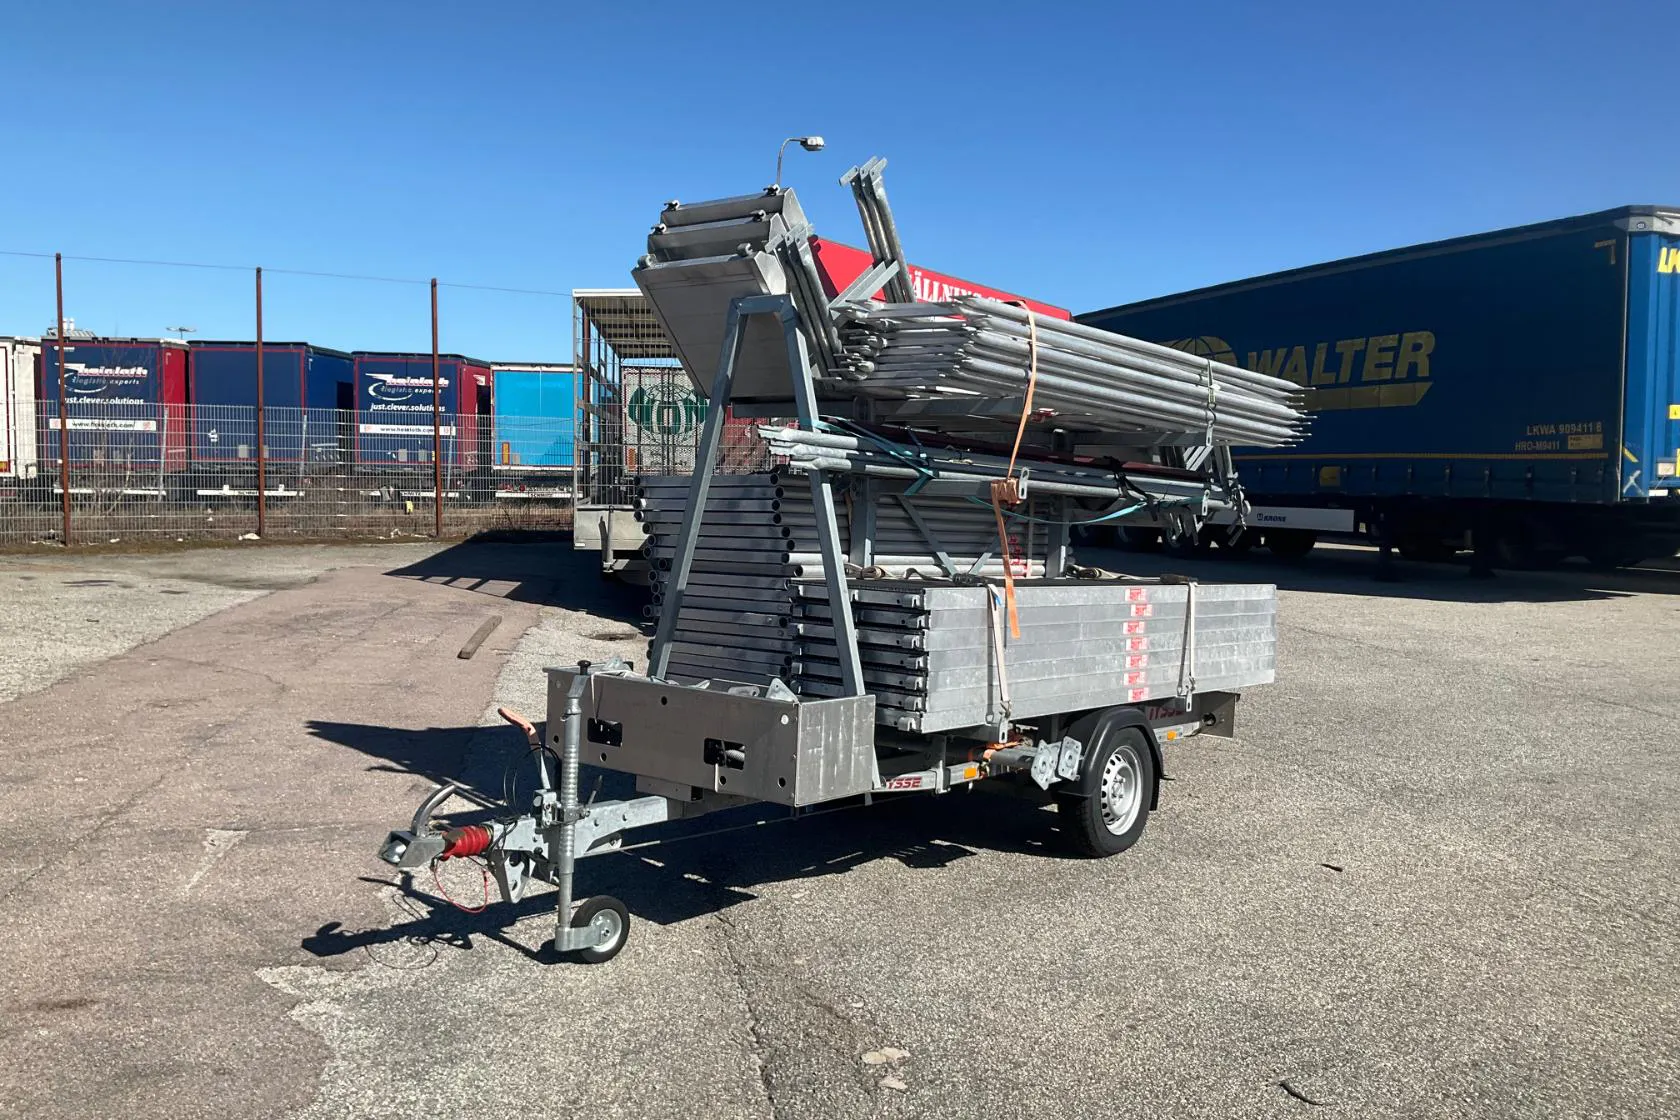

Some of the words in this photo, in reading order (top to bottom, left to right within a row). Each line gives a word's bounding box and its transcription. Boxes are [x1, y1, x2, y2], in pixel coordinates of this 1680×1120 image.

[1247, 331, 1436, 387] WALTER
[64, 396, 144, 405] ust.clever.solutions
[370, 402, 446, 412] just.clever.solutis
[1526, 424, 1556, 436] LKWA
